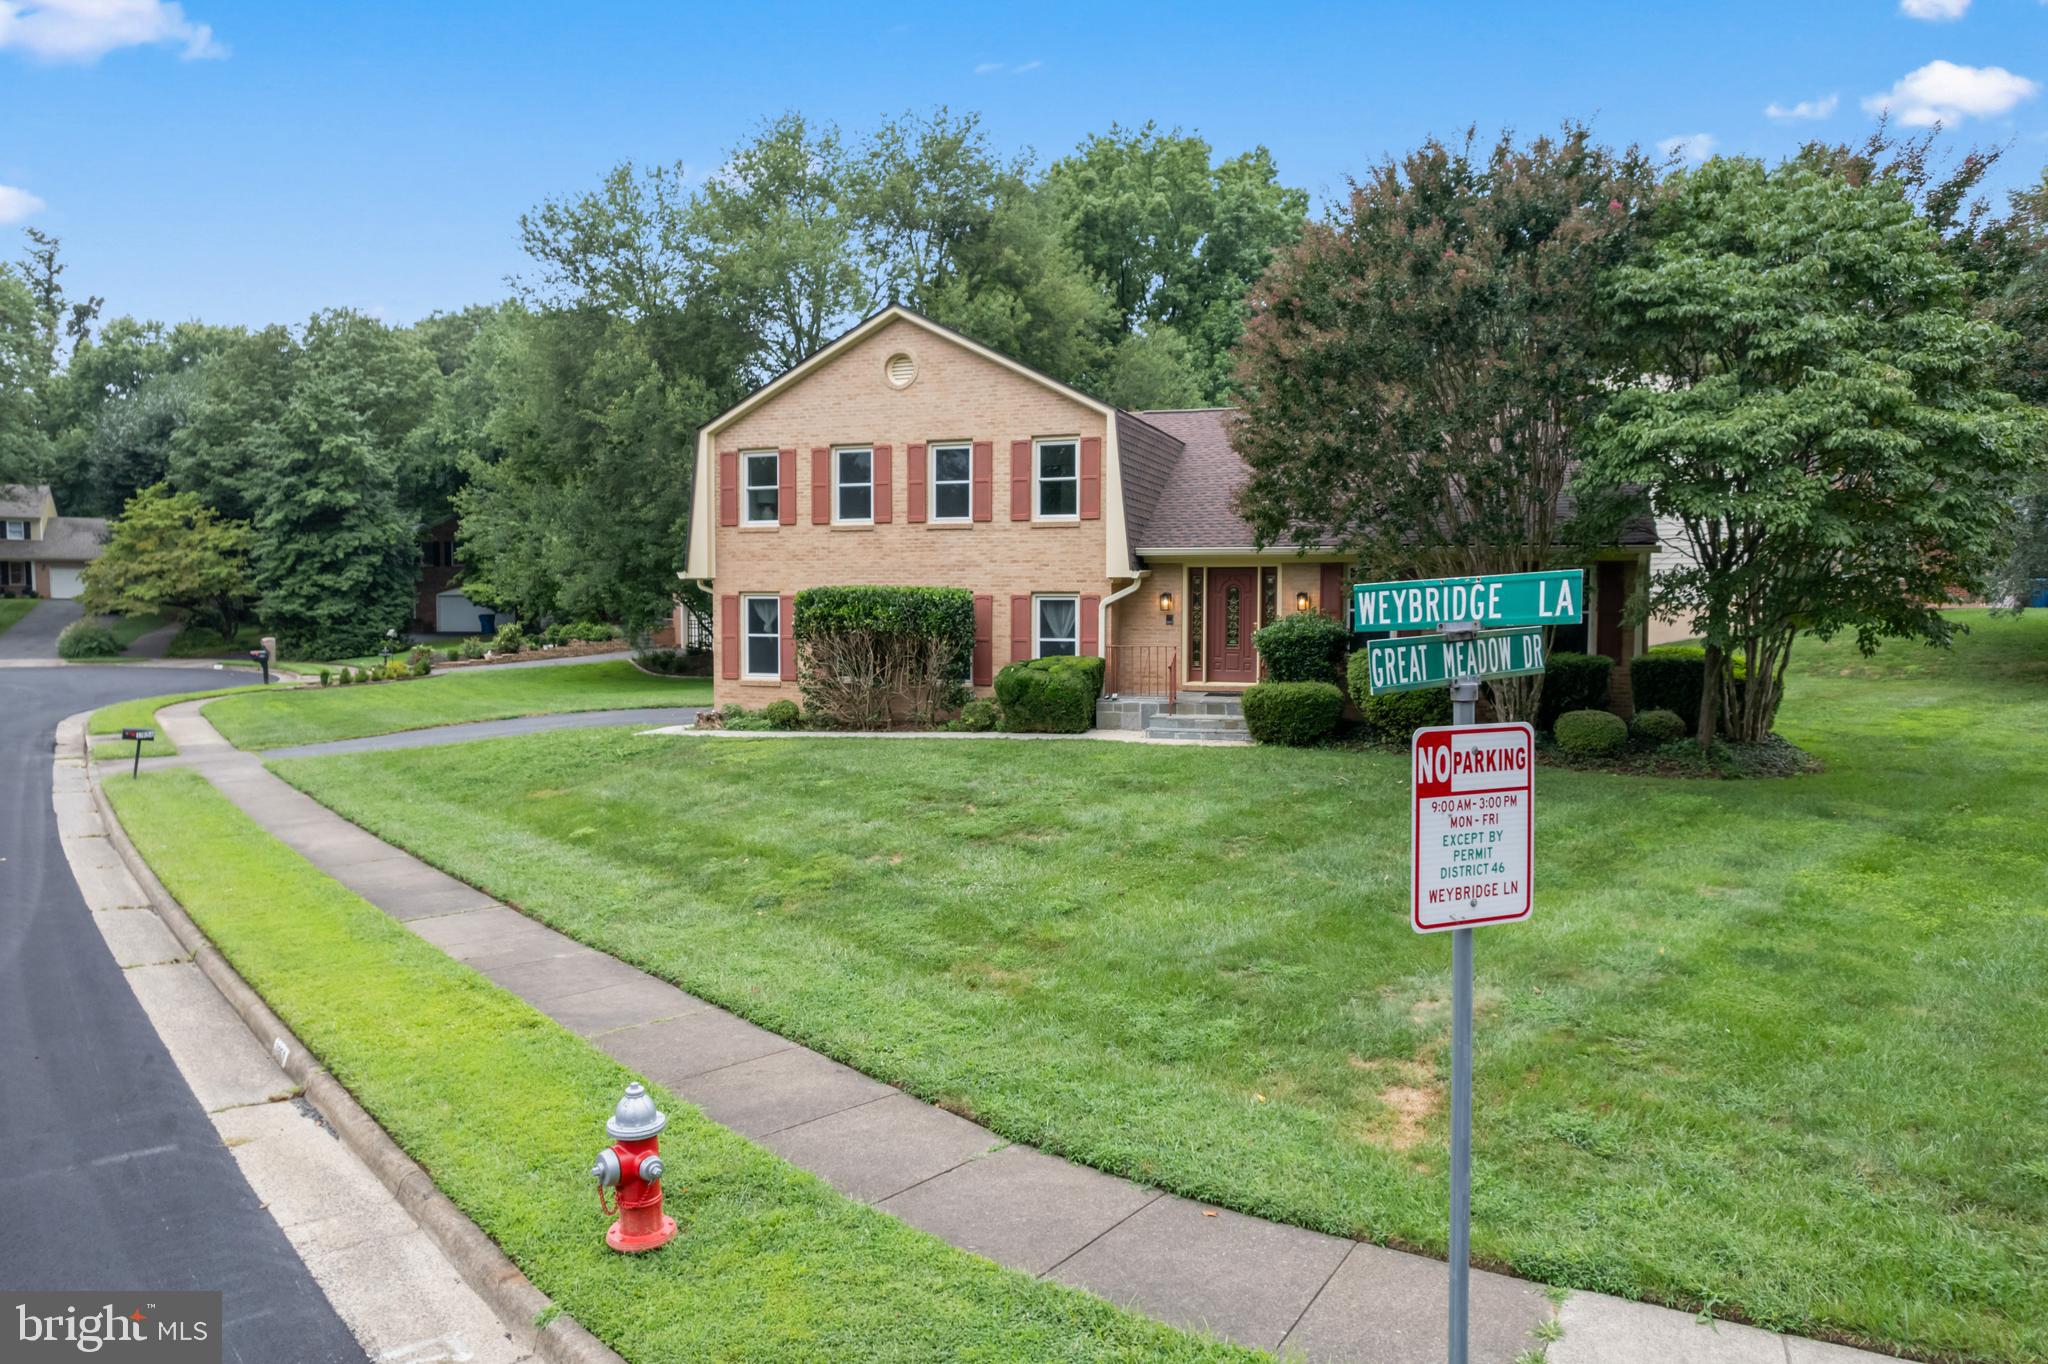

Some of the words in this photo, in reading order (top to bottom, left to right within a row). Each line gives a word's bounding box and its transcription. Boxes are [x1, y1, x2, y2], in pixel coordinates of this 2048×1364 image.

[1358, 583, 1503, 624] WEYBRIDGE
[1538, 579, 1574, 617] LA
[1372, 645, 1427, 688] GREAT
[1443, 637, 1511, 678] MEADOW
[1523, 634, 1543, 668] DR
[1418, 745, 1450, 784] NO
[1453, 747, 1525, 775] PARKING
[1432, 800, 1454, 812] 9:00
[1479, 797, 1501, 809] 3:00
[1504, 795, 1517, 807] PM
[1450, 815, 1472, 828] MON
[1482, 813, 1498, 825] FRI
[1443, 832, 1484, 847] EXCEPT
[1490, 830, 1503, 843] BY
[1453, 847, 1493, 861] PERMIT
[1440, 863, 1489, 879] DISTRICT
[1492, 862, 1505, 873] 46
[1429, 883, 1498, 903] WEYBRIDGE
[1504, 881, 1518, 895] LN
